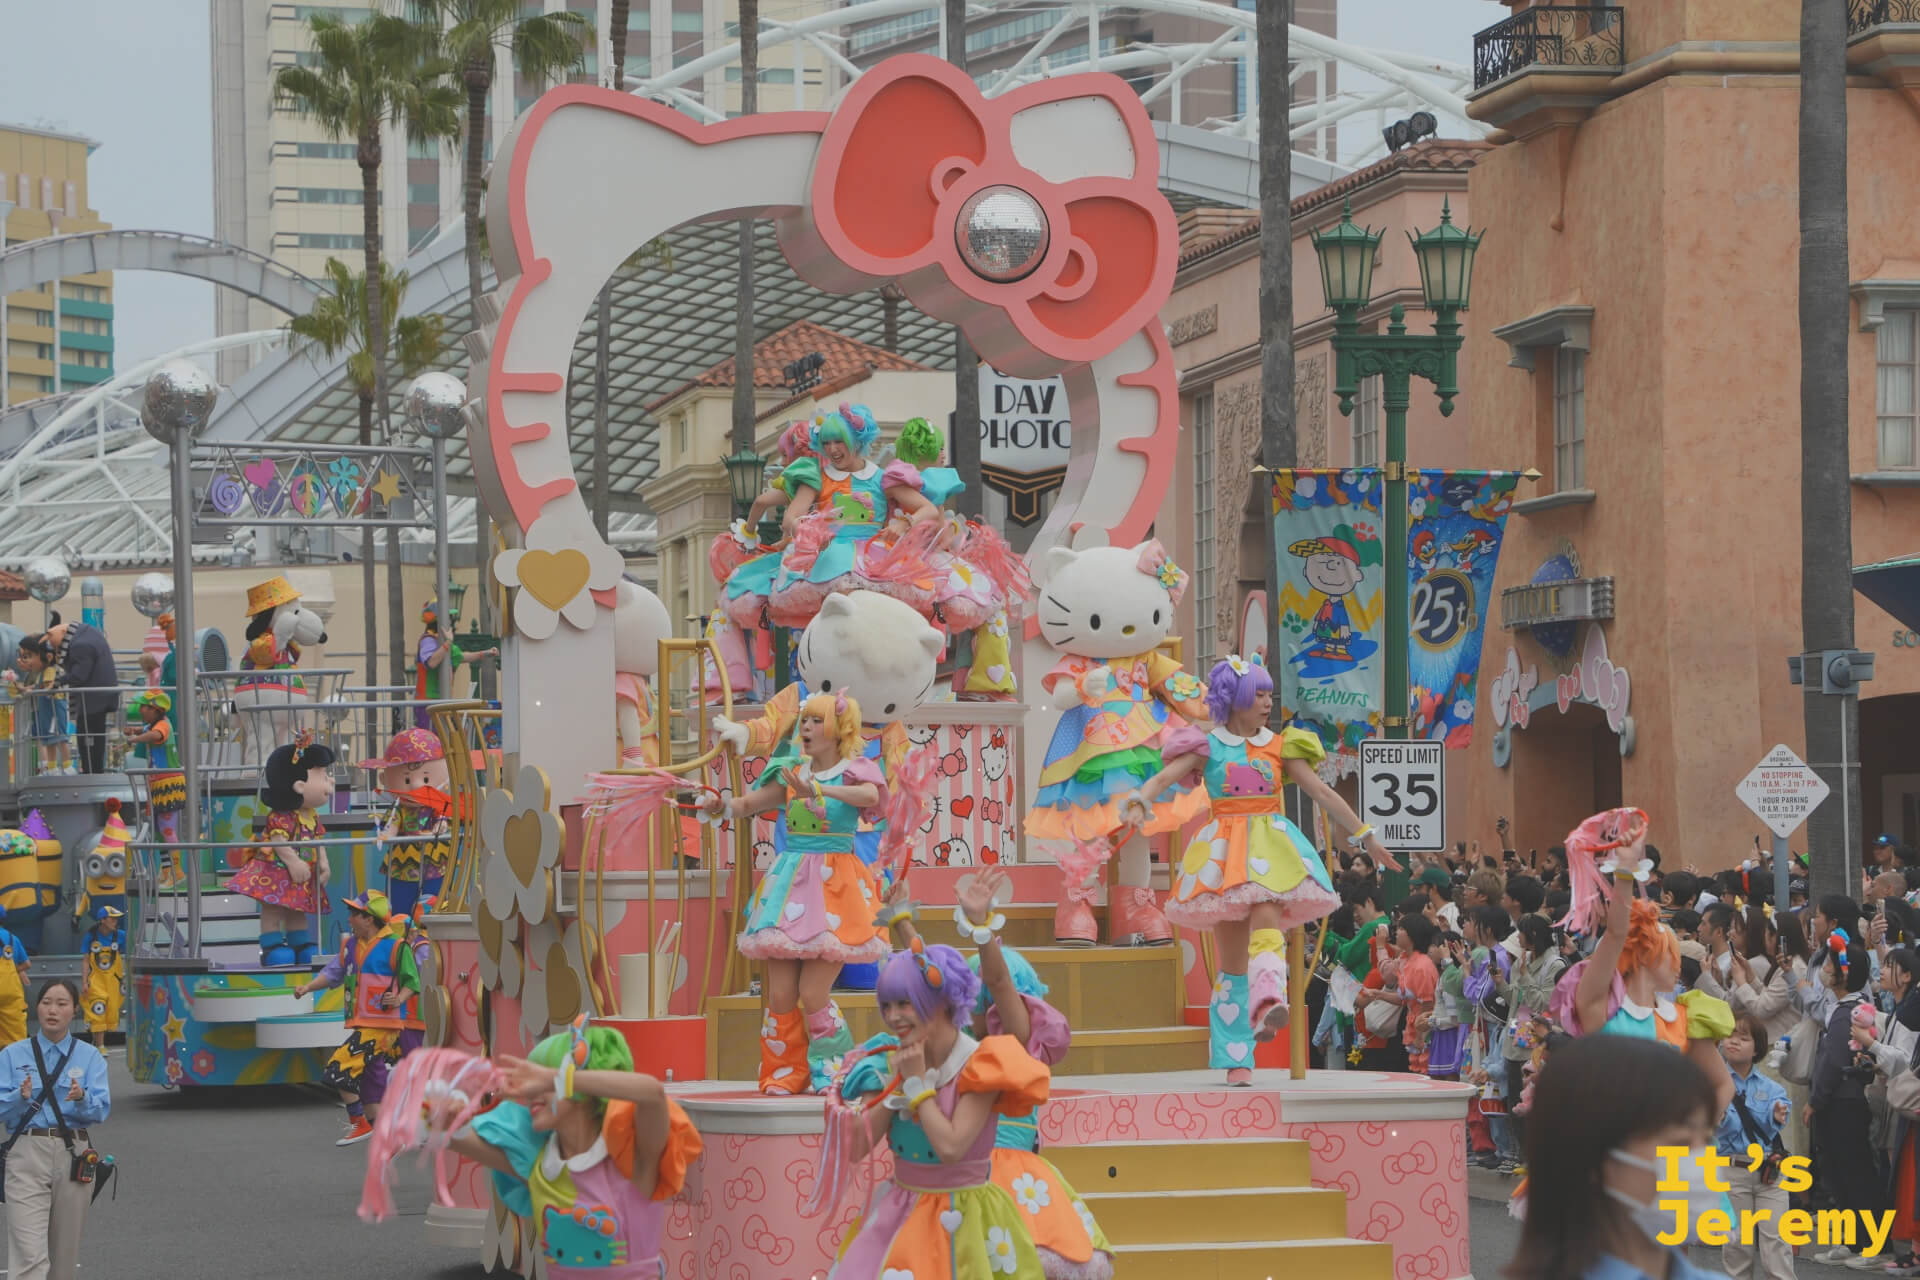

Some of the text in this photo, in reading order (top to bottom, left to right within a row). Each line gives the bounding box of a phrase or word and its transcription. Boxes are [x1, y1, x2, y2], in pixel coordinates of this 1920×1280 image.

[994, 384, 1057, 414] DAY
[1295, 686, 1369, 708] PEANUTS
[1365, 748, 1440, 764] SPEED LIMIT
[1761, 771, 1804, 779] NO STOPPING
[1759, 780, 1767, 788] 10
[1368, 772, 1438, 817] 35
[1763, 796, 1780, 804] HOUR
[1781, 796, 1809, 804] PARKING
[1384, 824, 1421, 840] MILES
